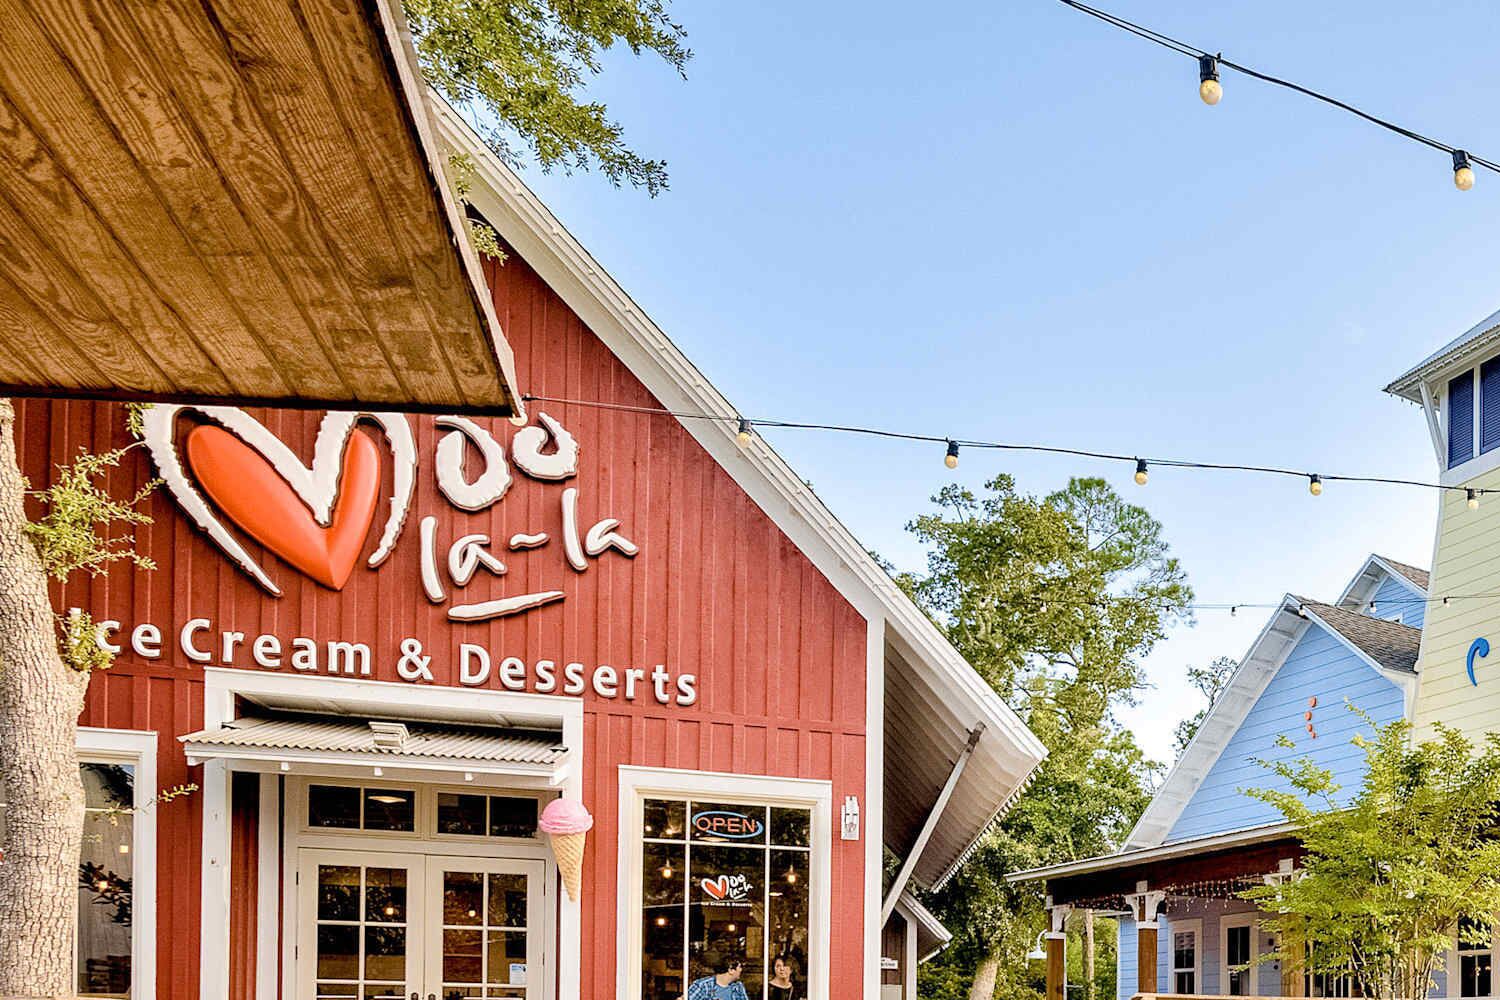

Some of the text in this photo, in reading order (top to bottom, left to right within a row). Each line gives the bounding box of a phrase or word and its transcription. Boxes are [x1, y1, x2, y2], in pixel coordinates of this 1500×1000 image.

[420, 487, 639, 603] la-la
[180, 617, 372, 676] Cream
[397, 637, 435, 682] &
[458, 643, 697, 705] Desserts
[696, 817, 756, 833] OPEN
